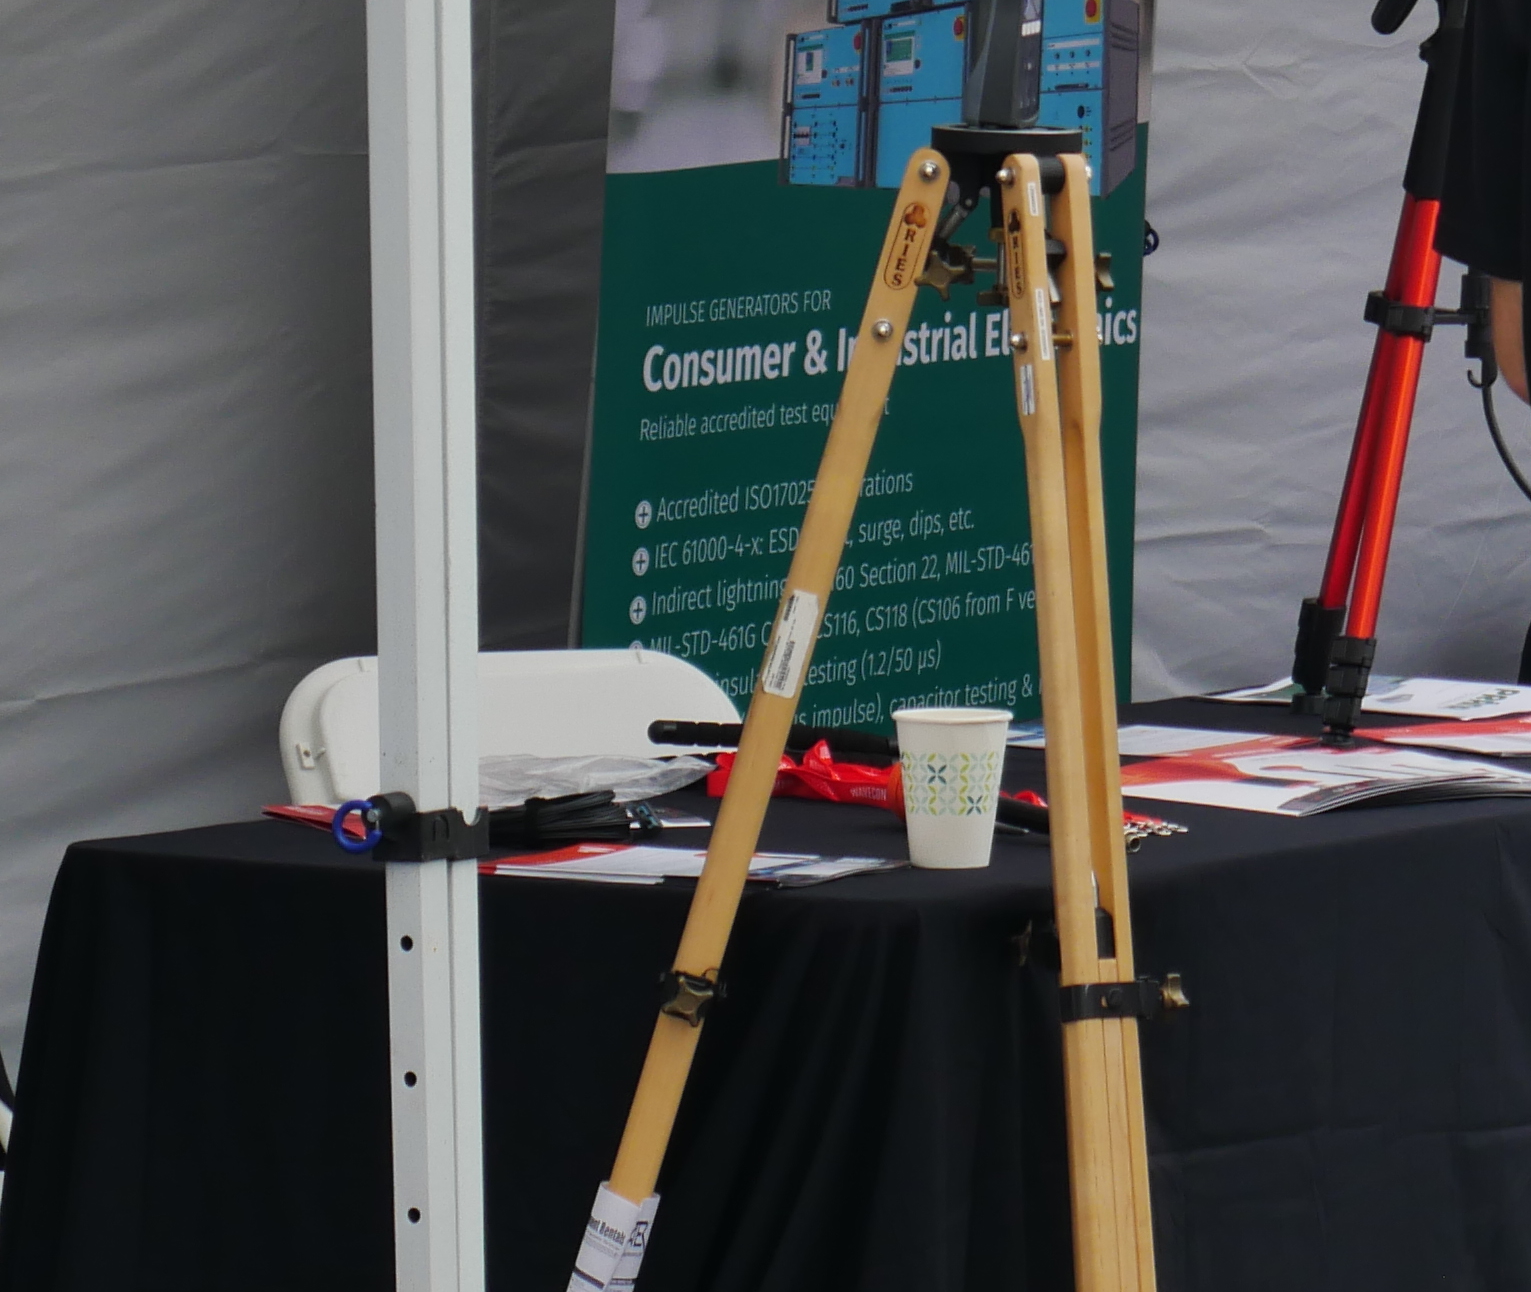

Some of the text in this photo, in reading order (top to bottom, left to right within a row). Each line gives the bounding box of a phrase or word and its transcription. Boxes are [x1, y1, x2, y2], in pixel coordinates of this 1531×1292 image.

[646, 289, 832, 327] IMPULSE GENERATORS FOR
[643, 340, 797, 393] Consumer
[803, 328, 829, 376] &
[640, 412, 697, 441] Reliable
[700, 402, 775, 437] accredited
[779, 401, 808, 426] test
[656, 485, 740, 523] Accredited
[654, 541, 678, 569] IEC
[682, 534, 764, 566] 61000-4-x:
[858, 518, 905, 546] surge,
[909, 509, 945, 541] dips,
[949, 507, 975, 532] etc.
[652, 585, 712, 616] Indirect
[859, 556, 917, 588] Section
[921, 554, 942, 583] 22,
[816, 610, 860, 639] S116,
[865, 603, 908, 632] CS118
[912, 596, 961, 628] (CS106
[965, 590, 1001, 619] from
[1006, 588, 1016, 612] F
[803, 655, 857, 686] esting
[861, 645, 913, 680] (1.2/50
[965, 675, 1018, 707] testing
[1021, 673, 1034, 698] &
[850, 784, 887, 802] WAVECON
